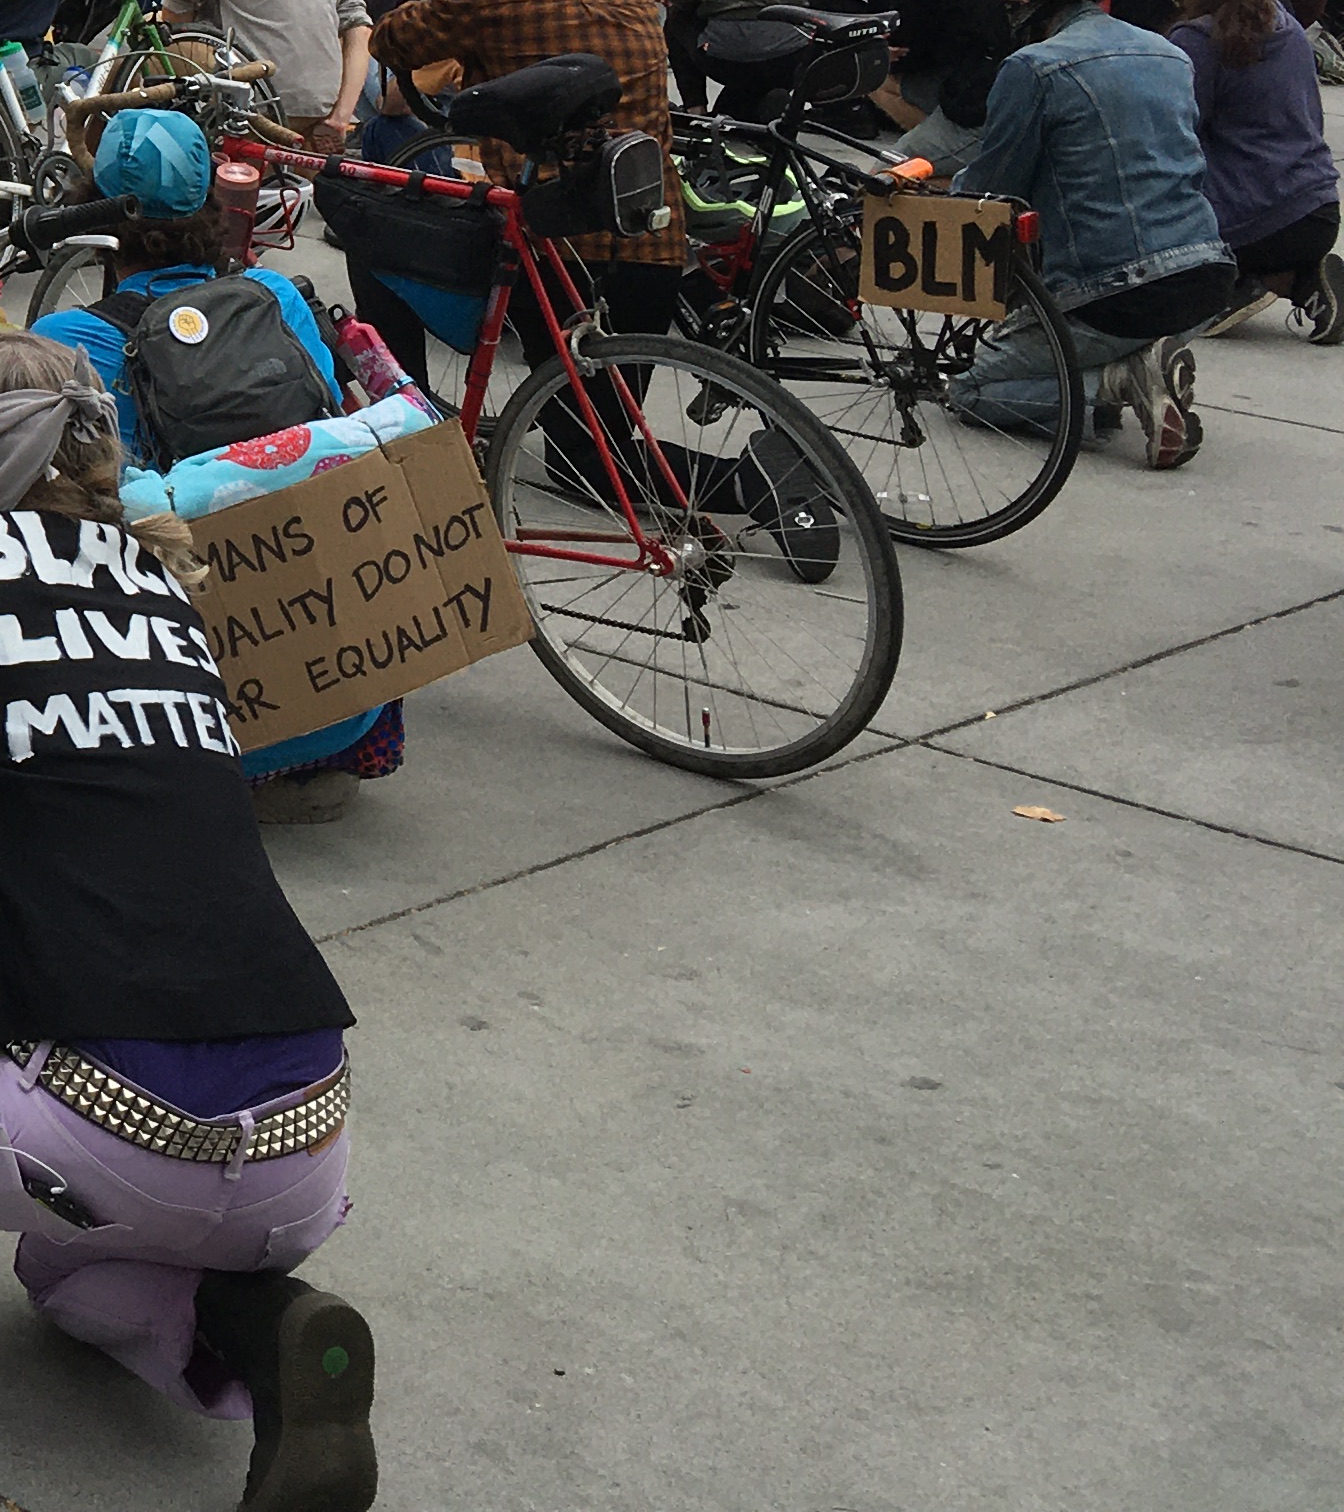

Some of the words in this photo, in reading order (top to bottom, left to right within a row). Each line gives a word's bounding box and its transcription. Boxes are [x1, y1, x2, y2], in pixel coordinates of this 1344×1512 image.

[848, 26, 878, 38] WTB
[873, 216, 1011, 304] BLM
[341, 486, 388, 533] OF
[211, 578, 336, 662] UALITY
[305, 577, 493, 693] EQUALITY
